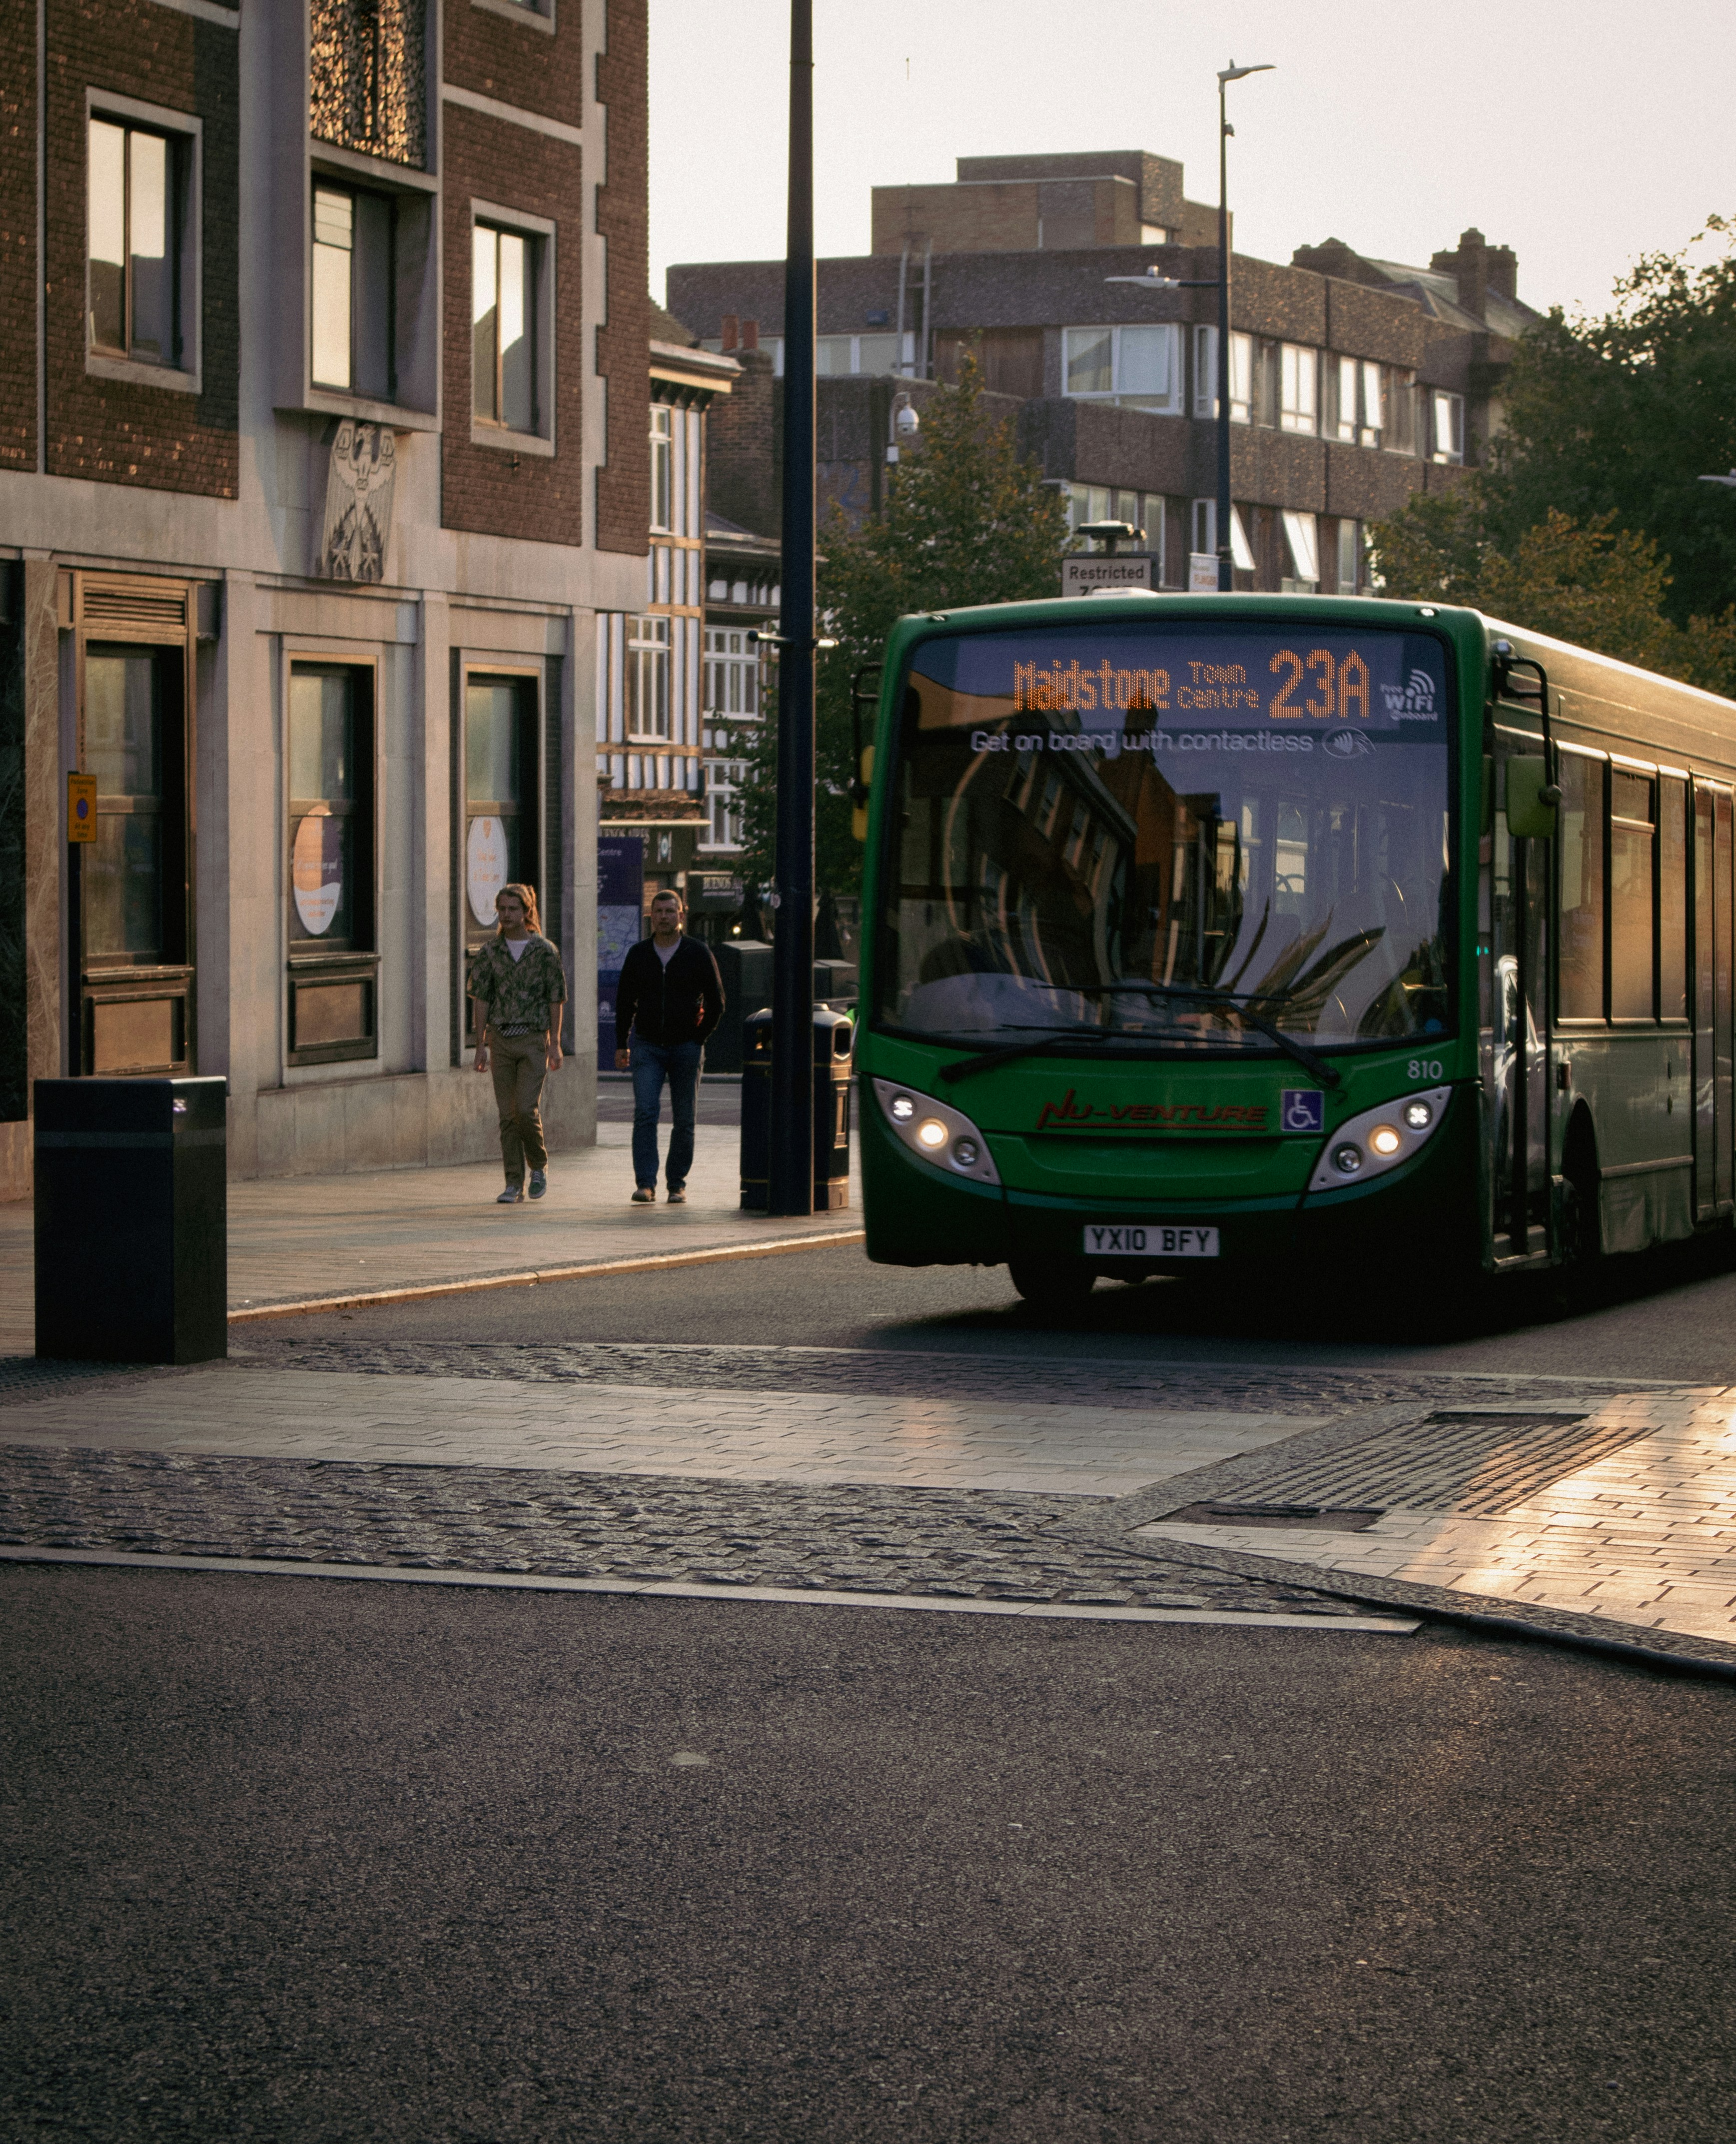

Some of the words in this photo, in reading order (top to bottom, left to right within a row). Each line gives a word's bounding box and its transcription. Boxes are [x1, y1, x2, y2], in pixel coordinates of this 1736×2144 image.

[1070, 565, 1144, 580] Restricted
[1187, 661, 1246, 684] Town
[1269, 649, 1370, 718] 23A
[1014, 659, 1170, 710] Maidstone
[1177, 686, 1259, 709] Centre
[1385, 689, 1433, 711] WiFi
[971, 731, 1010, 751] Get
[1014, 735, 1042, 751] on
[1049, 730, 1117, 751] board
[1122, 729, 1173, 751] with
[1179, 731, 1314, 751] contactless
[1408, 1060, 1443, 1079] 810
[1091, 1227, 1146, 1250] YX10
[1162, 1229, 1210, 1252] BFY
